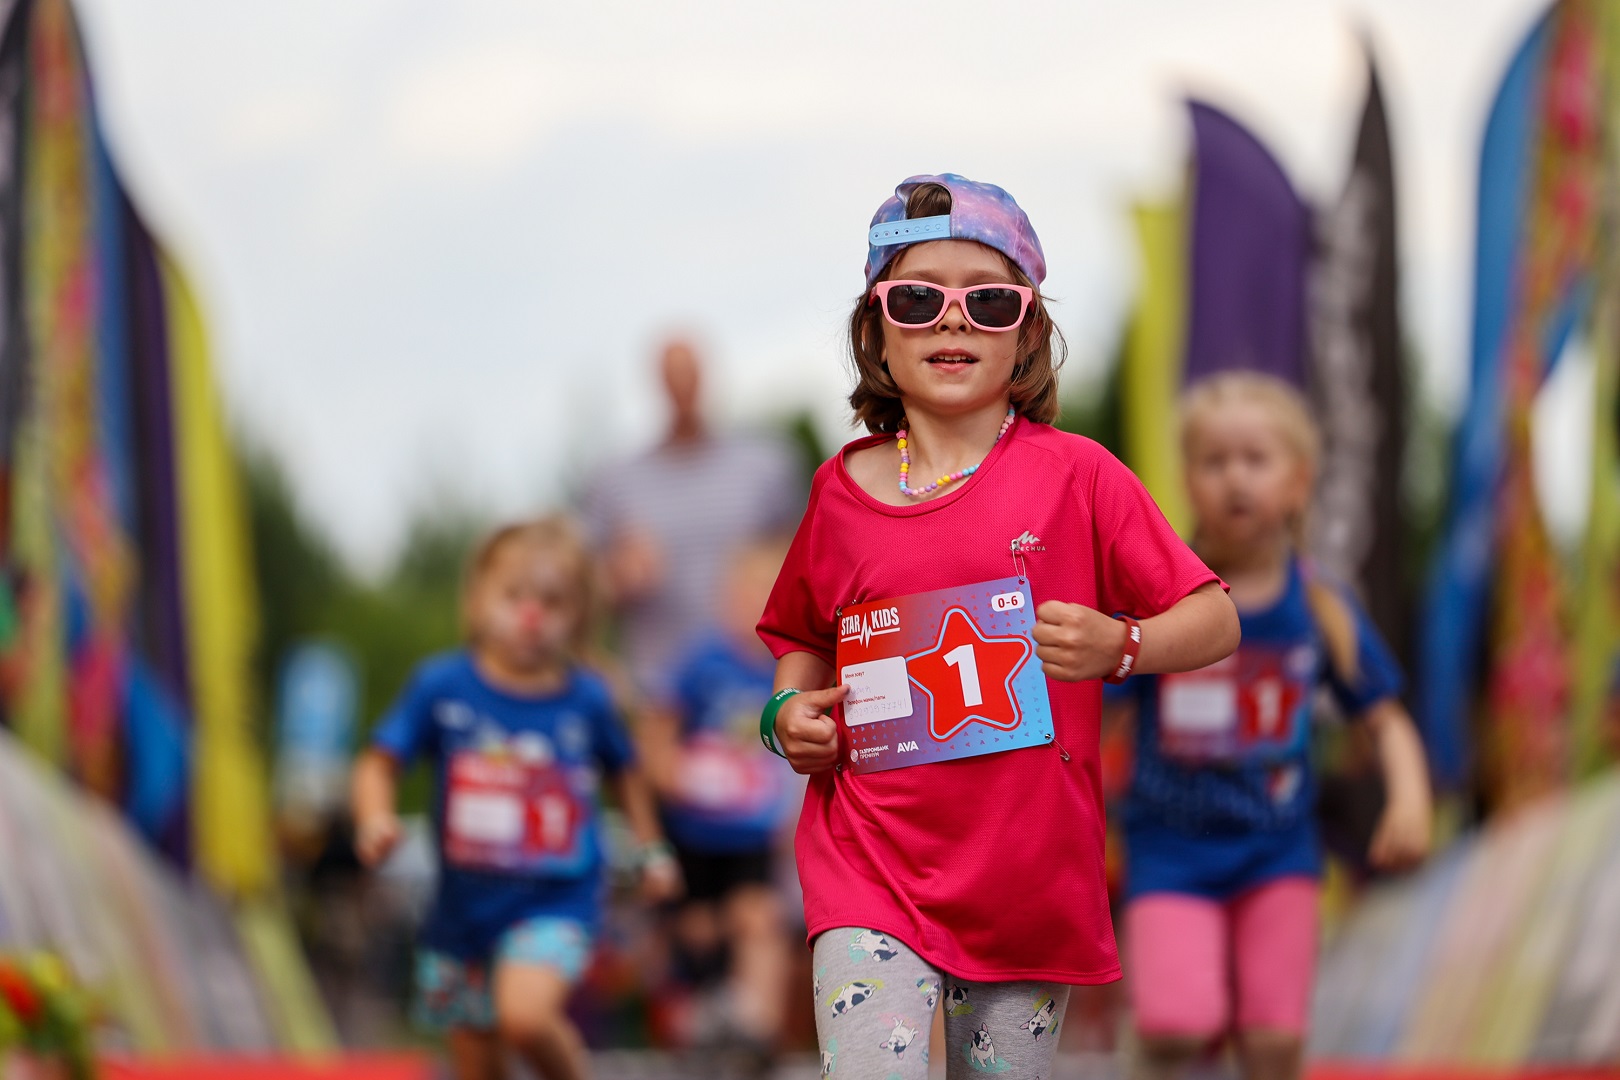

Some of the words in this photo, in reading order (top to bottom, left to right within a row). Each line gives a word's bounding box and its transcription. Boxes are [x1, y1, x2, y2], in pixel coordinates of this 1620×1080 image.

[997, 595, 1019, 609] 0-6
[841, 614, 860, 636] STAR
[871, 606, 900, 629] KIDS
[942, 643, 983, 707] 1
[897, 740, 919, 753] AVA
